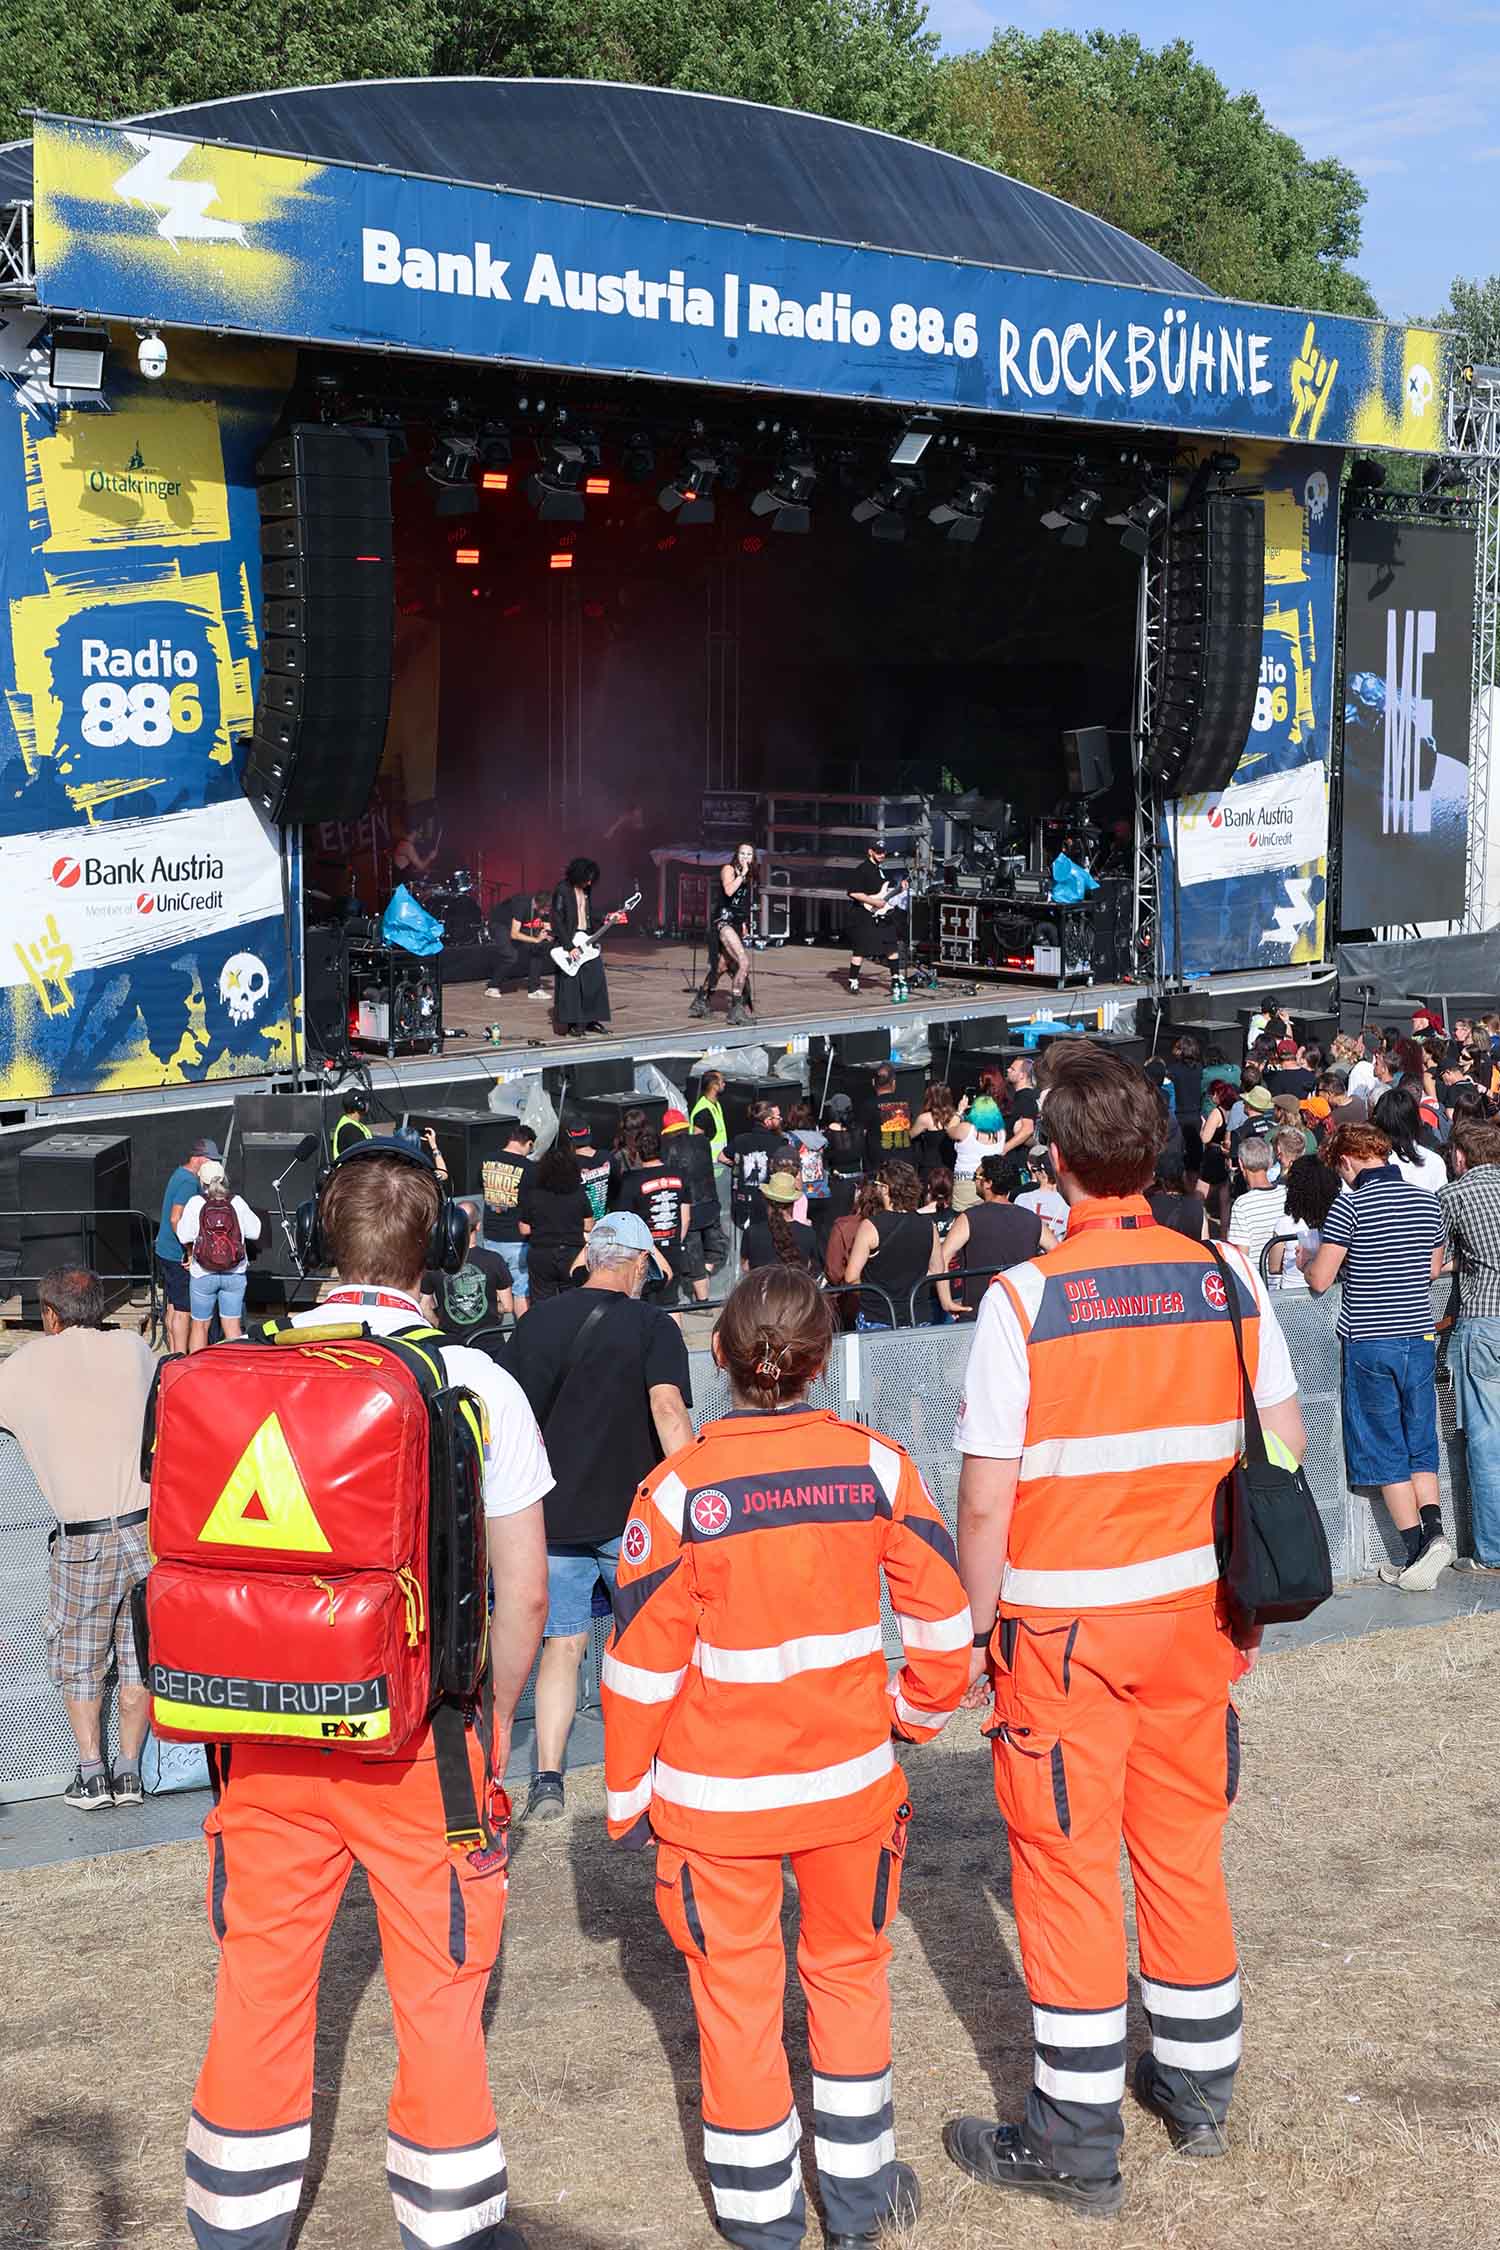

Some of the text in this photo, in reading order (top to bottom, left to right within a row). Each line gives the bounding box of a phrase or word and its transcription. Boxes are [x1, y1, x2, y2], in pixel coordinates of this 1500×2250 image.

[362, 228, 512, 301] Bank
[524, 253, 714, 327] Austria
[749, 283, 880, 347] Radio
[890, 303, 978, 358] 88.6
[1000, 307, 1273, 398] ROCKBÜHNE
[90, 471, 181, 500] Ottakringer
[81, 639, 198, 678] Radio
[1258, 656, 1287, 683] dio
[81, 682, 203, 747] 886
[1251, 686, 1289, 731] 86
[1223, 806, 1294, 828] Bank Austria
[1258, 832, 1293, 847] UniCredit
[85, 853, 224, 886] Bank Austria
[156, 890, 223, 913] UniCredit
[1064, 1277, 1099, 1302] DIE
[1069, 1291, 1185, 1324] JOHANNITER
[742, 1483, 876, 1514] JOHANNITER
[154, 1665, 249, 1708] BERGE
[253, 1681, 365, 1714] TRUPP
[321, 1719, 367, 1738] PAX
